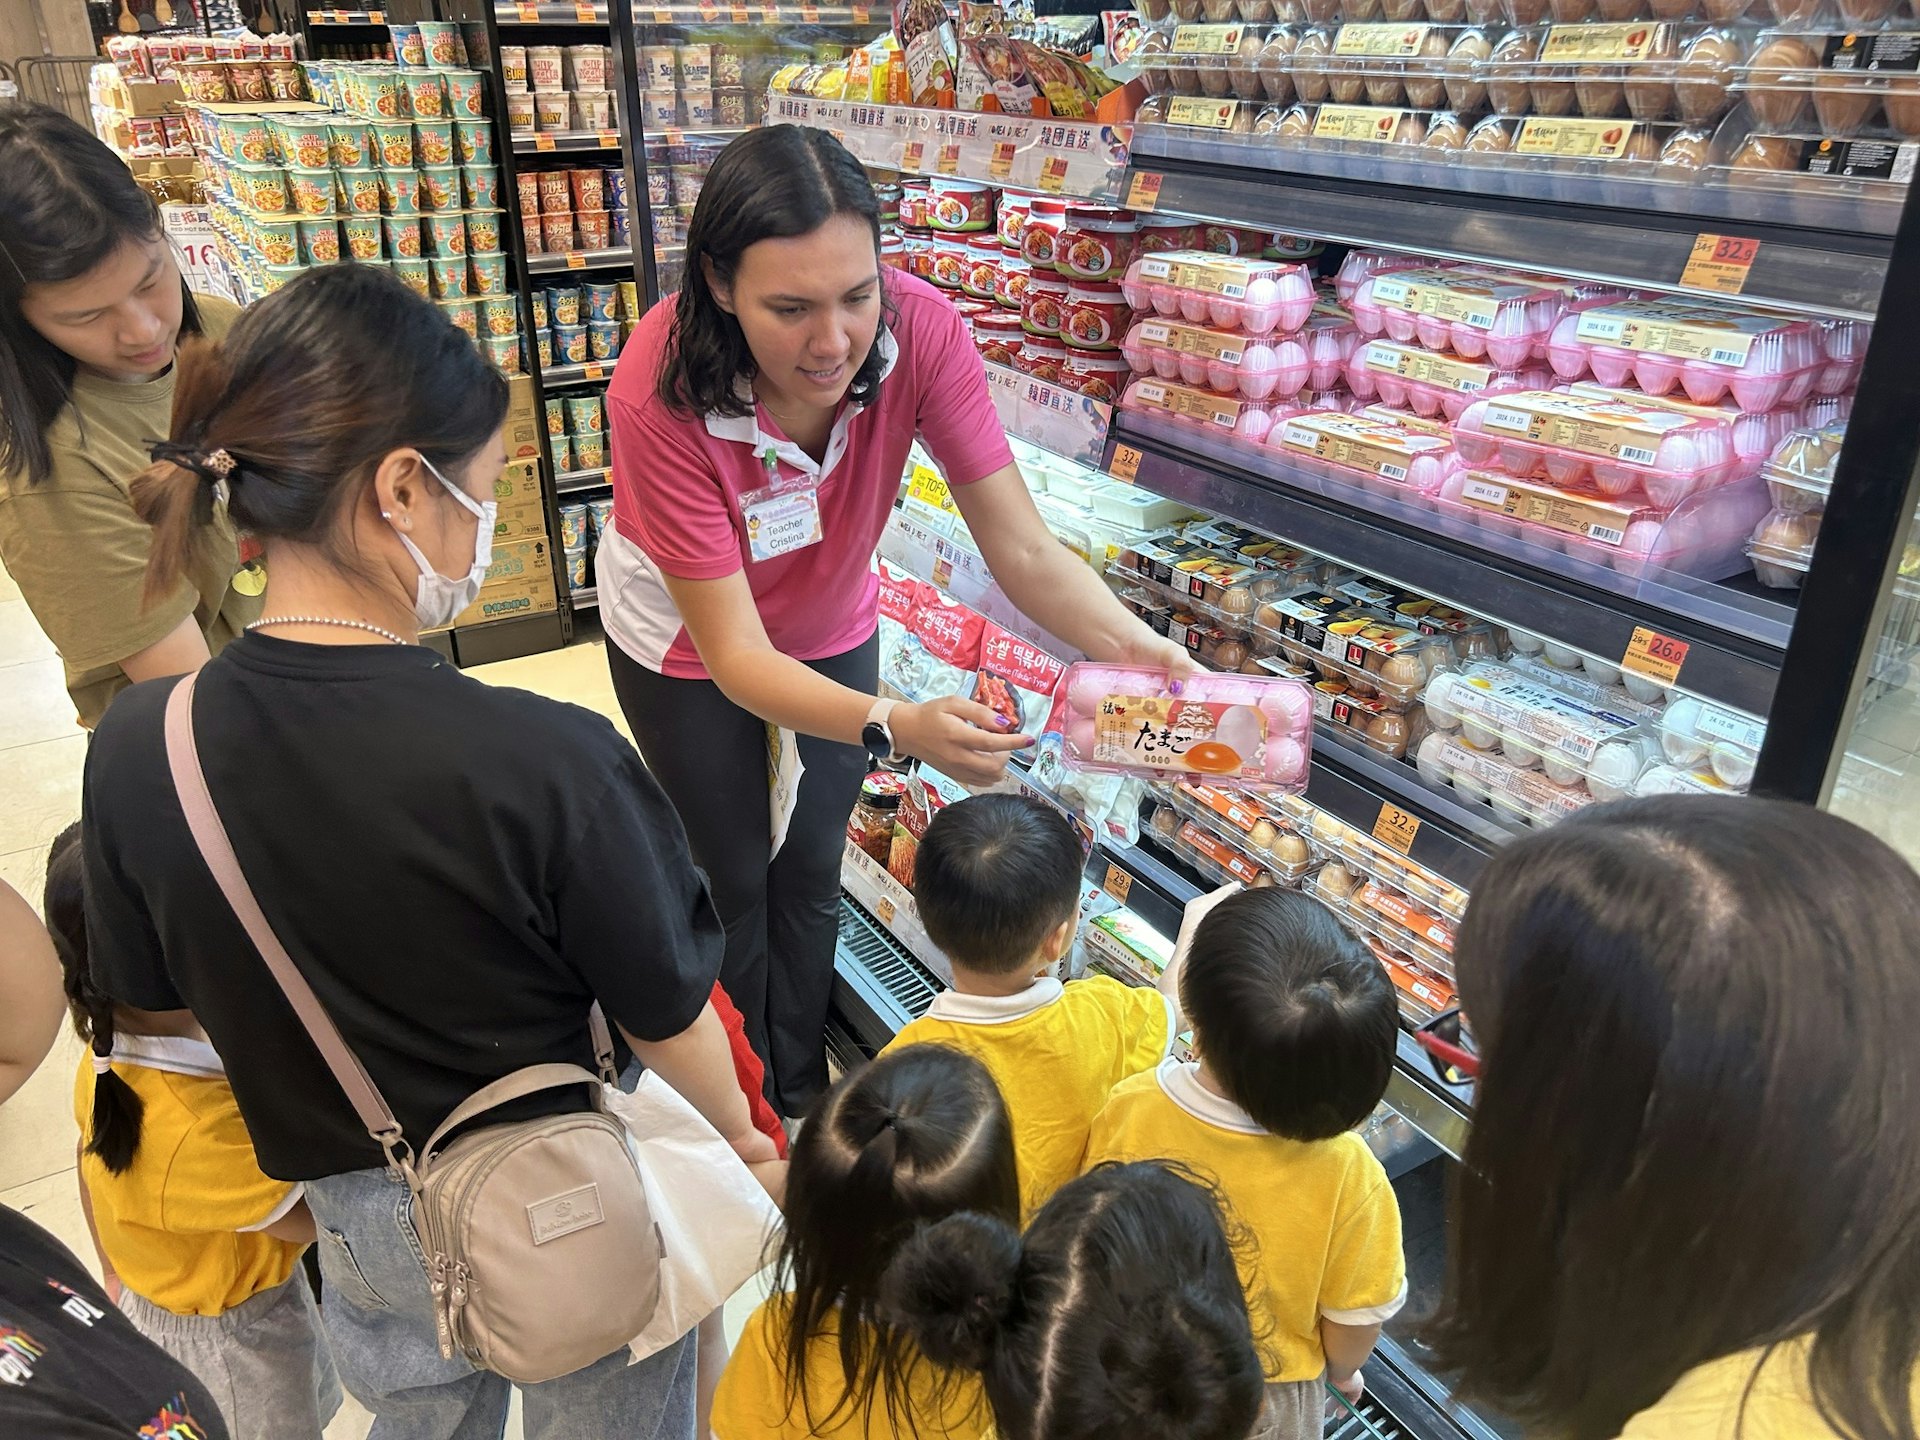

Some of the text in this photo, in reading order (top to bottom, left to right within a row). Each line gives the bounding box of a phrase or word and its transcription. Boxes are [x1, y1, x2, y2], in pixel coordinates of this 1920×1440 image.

[1040, 126, 1091, 150] 韓國直送
[1716, 239, 1753, 261] 32.9
[1029, 383, 1074, 414] 韓國直送
[1122, 449, 1140, 467] 32.9
[925, 477, 948, 497] TOFU
[767, 518, 804, 537] Teacher
[769, 531, 805, 550] Cristina
[986, 636, 1062, 679] 순쌀 떡볶이떡
[1651, 638, 1682, 662] 26.0
[1134, 721, 1194, 754] たまご
[1389, 811, 1415, 835] 32.9
[1114, 871, 1129, 890] 29.9
